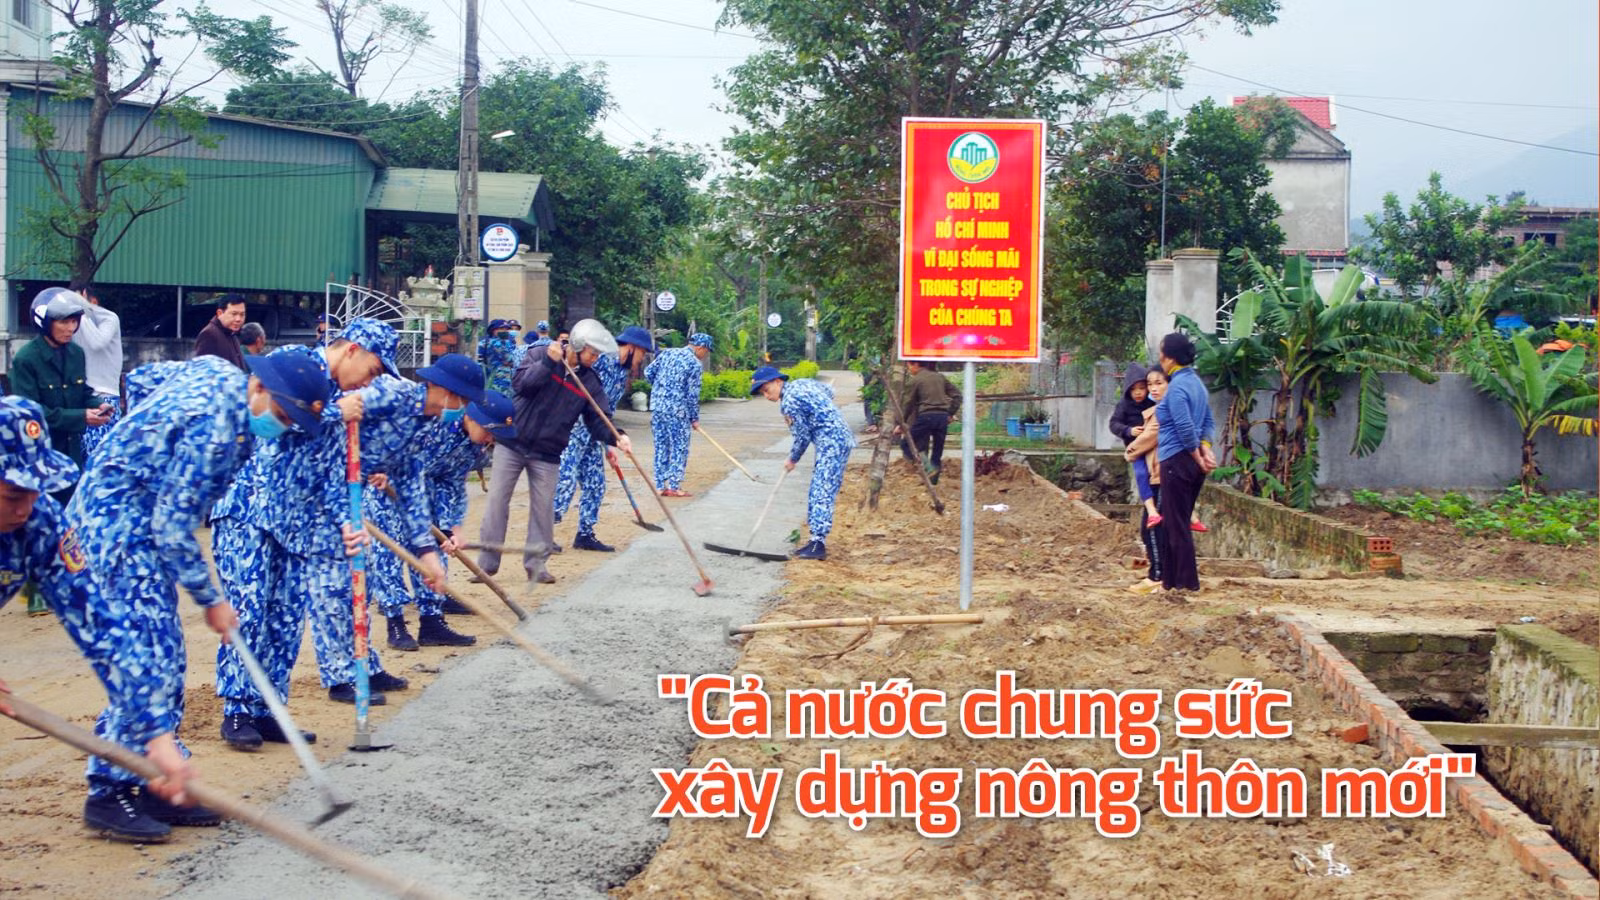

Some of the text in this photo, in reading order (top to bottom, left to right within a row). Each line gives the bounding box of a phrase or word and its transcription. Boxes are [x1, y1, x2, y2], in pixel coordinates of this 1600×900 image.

[946, 186, 1000, 213] CHỦ TỊCH
[954, 217, 975, 239] CHÍ
[977, 221, 1010, 239] MINH
[924, 244, 1020, 271] VĨ ĐẠI SỐNG MÃI
[919, 276, 1024, 301] TRONG SỰ NGHIỆP
[929, 302, 1013, 326] CỦA CHÚNG TA
